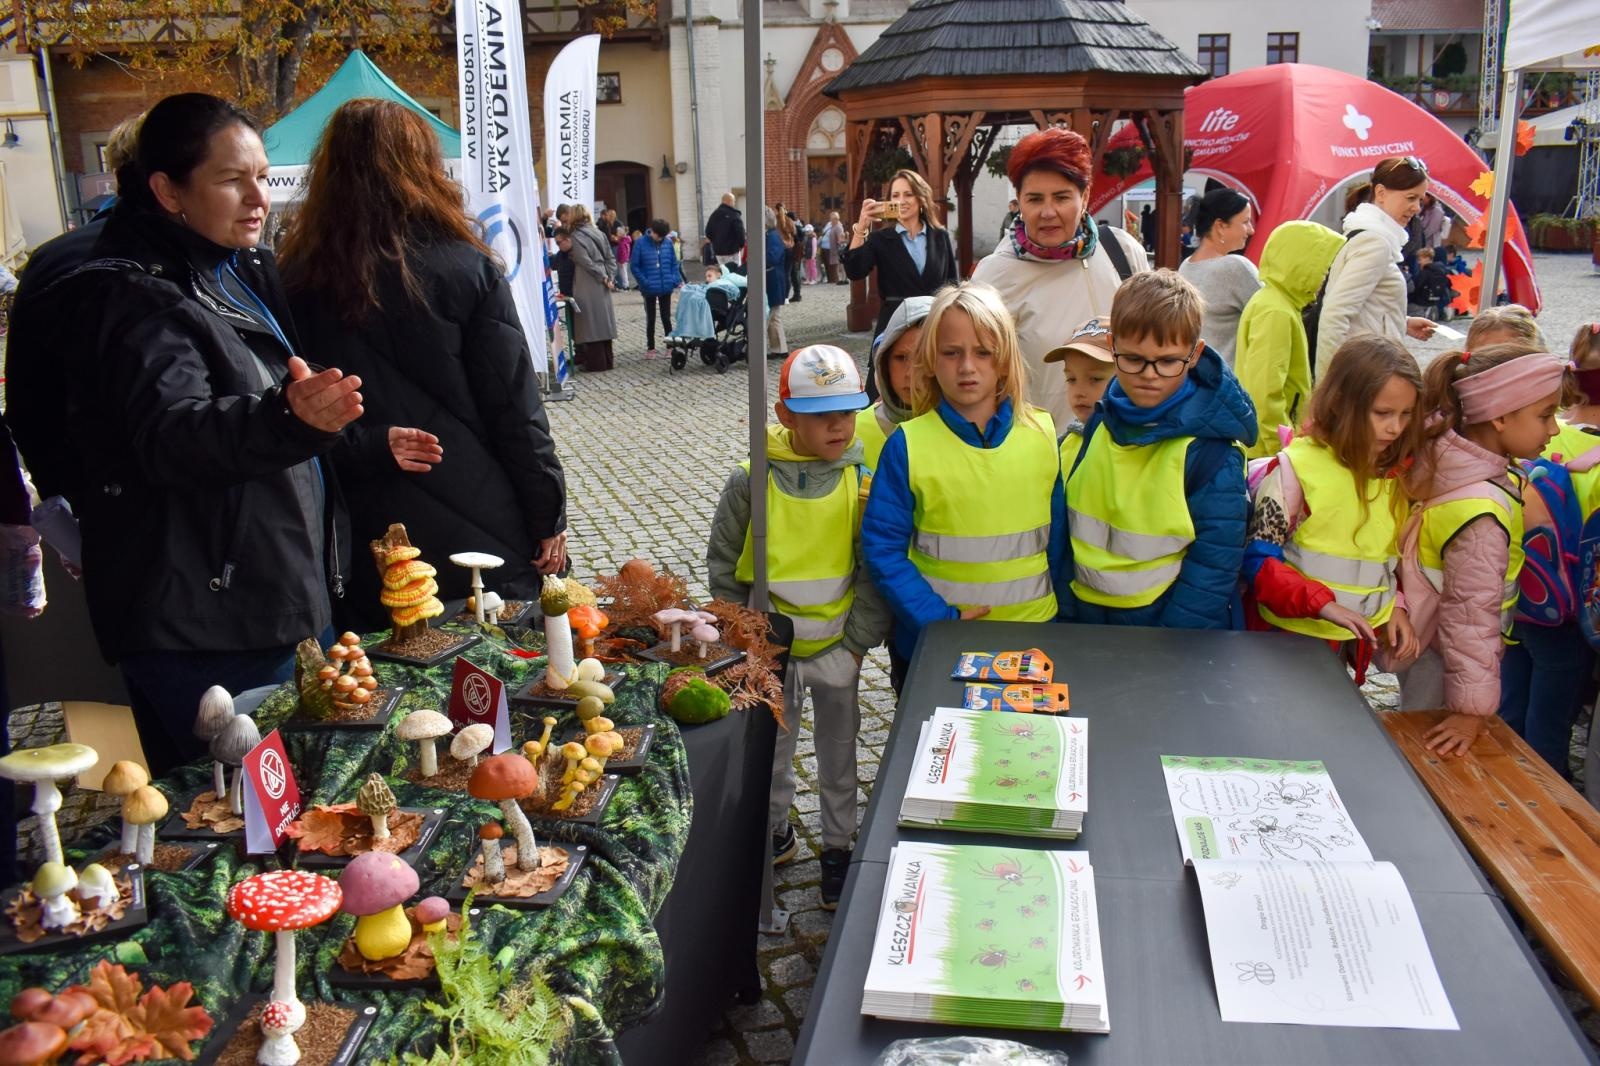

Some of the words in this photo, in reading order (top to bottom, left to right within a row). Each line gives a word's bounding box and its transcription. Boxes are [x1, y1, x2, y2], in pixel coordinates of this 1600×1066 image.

[1200, 107, 1240, 132] life
[559, 91, 572, 199] AKADEMIA
[582, 109, 590, 167] RACIBORZU
[1330, 145, 1360, 158] PUNKT
[1361, 141, 1415, 157] MEDYCZNY
[582, 170, 588, 180] W
[280, 801, 290, 816] NIE
